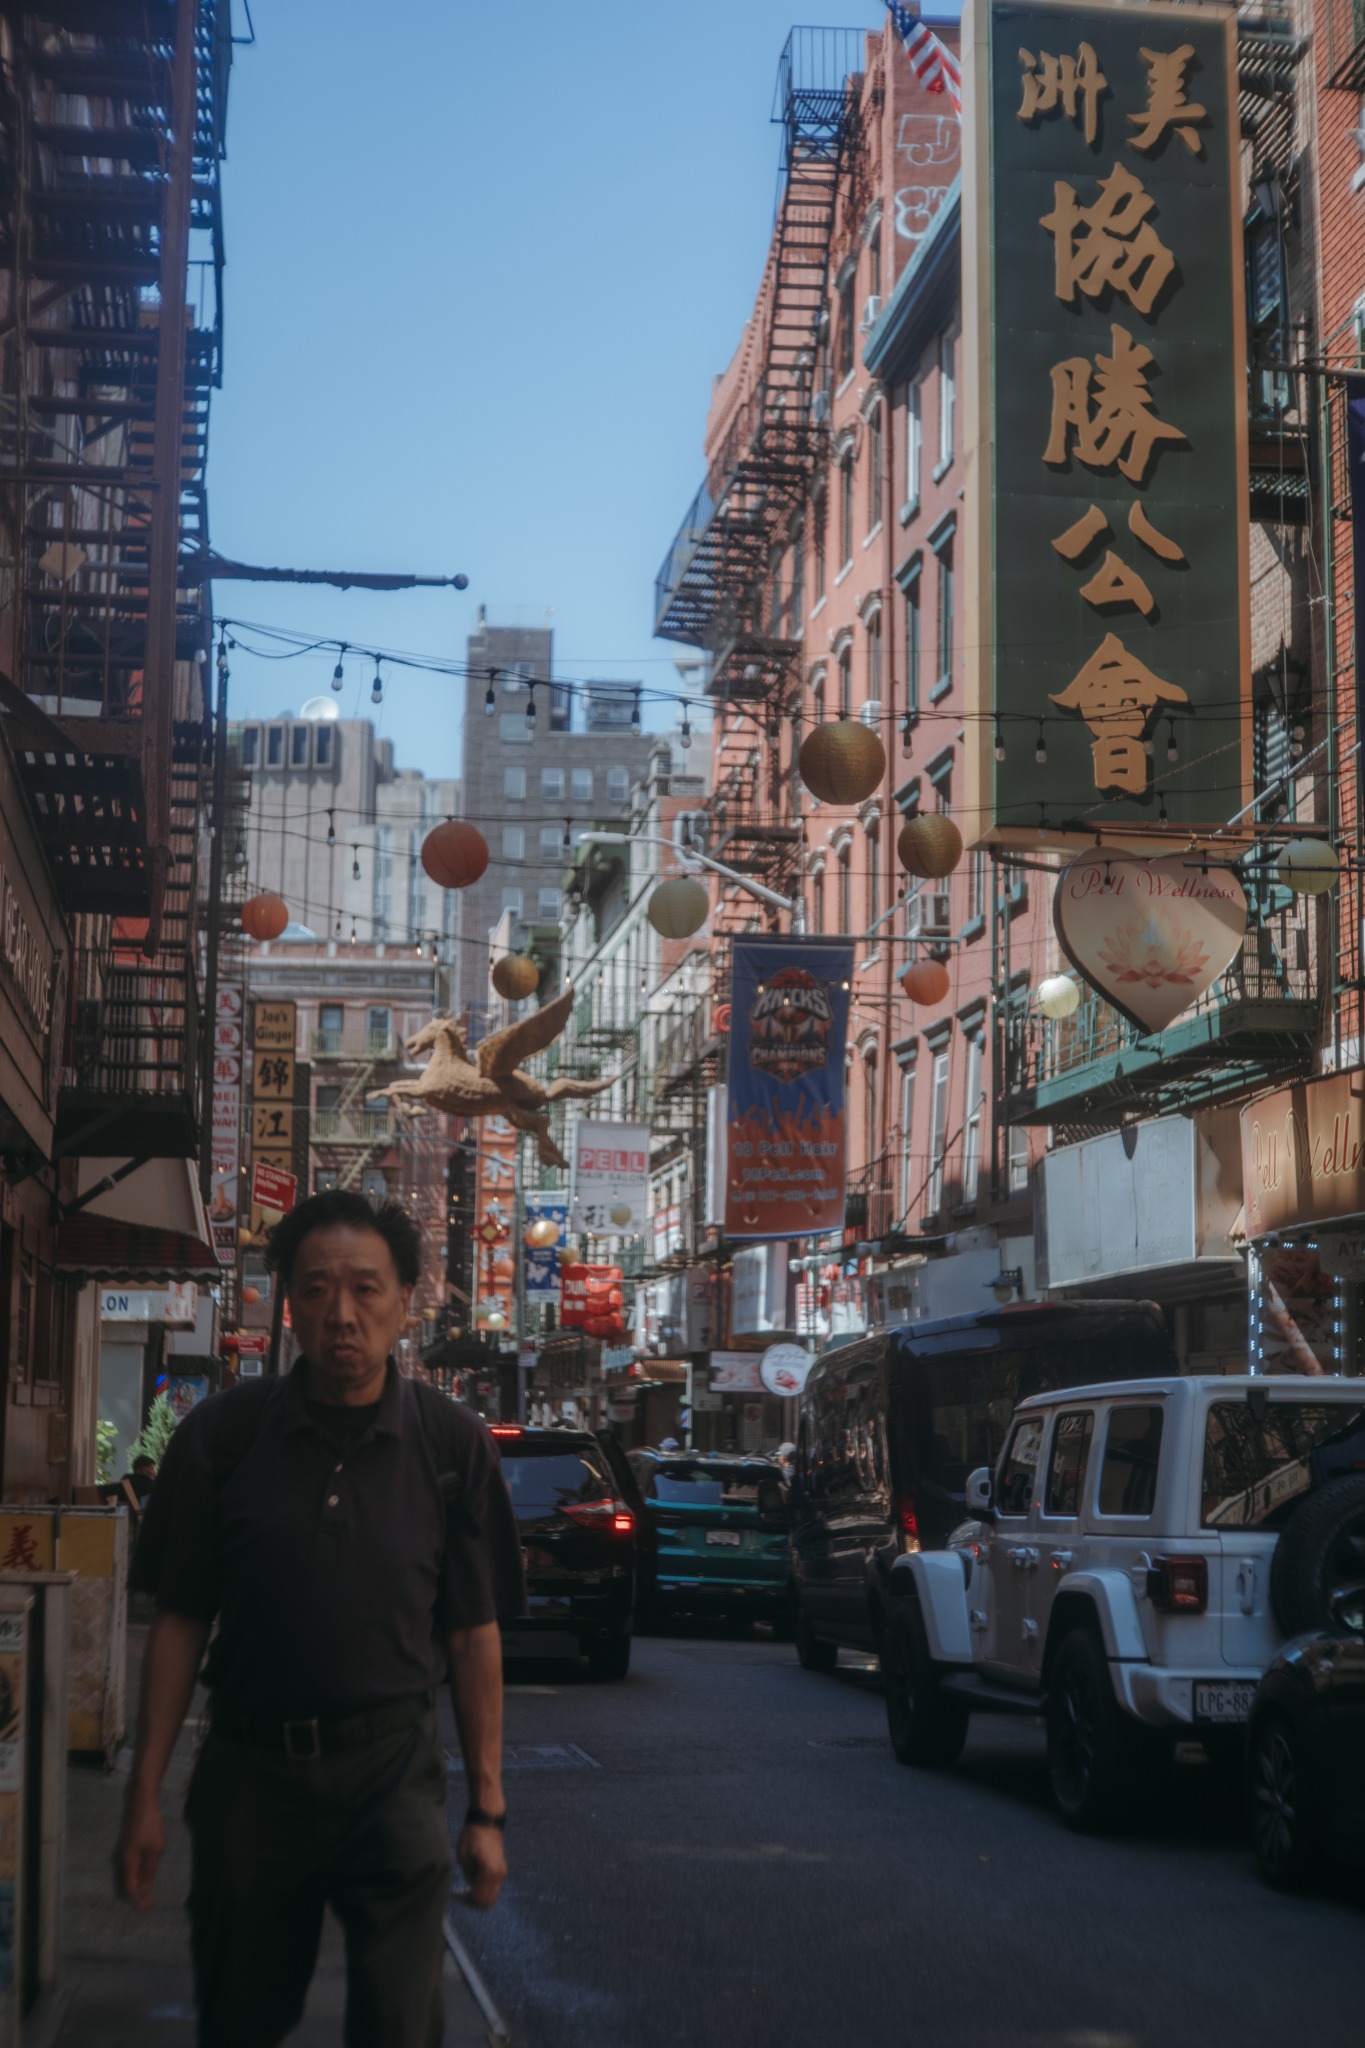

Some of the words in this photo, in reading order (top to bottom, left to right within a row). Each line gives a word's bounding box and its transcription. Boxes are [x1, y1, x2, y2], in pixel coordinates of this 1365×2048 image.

[1137, 868, 1237, 899] Wellness
[262, 1007, 288, 1023] Joe's
[256, 1026, 293, 1044] Ginger
[752, 1047, 826, 1065] CHAMPIONS
[212, 1091, 236, 1102] MEI
[213, 1105, 235, 1115] LAI
[759, 1140, 792, 1156] Pell
[799, 1140, 838, 1156] Hair
[579, 1149, 645, 1172] PELL
[257, 1167, 265, 1177] NO
[265, 1170, 290, 1187] STANDING
